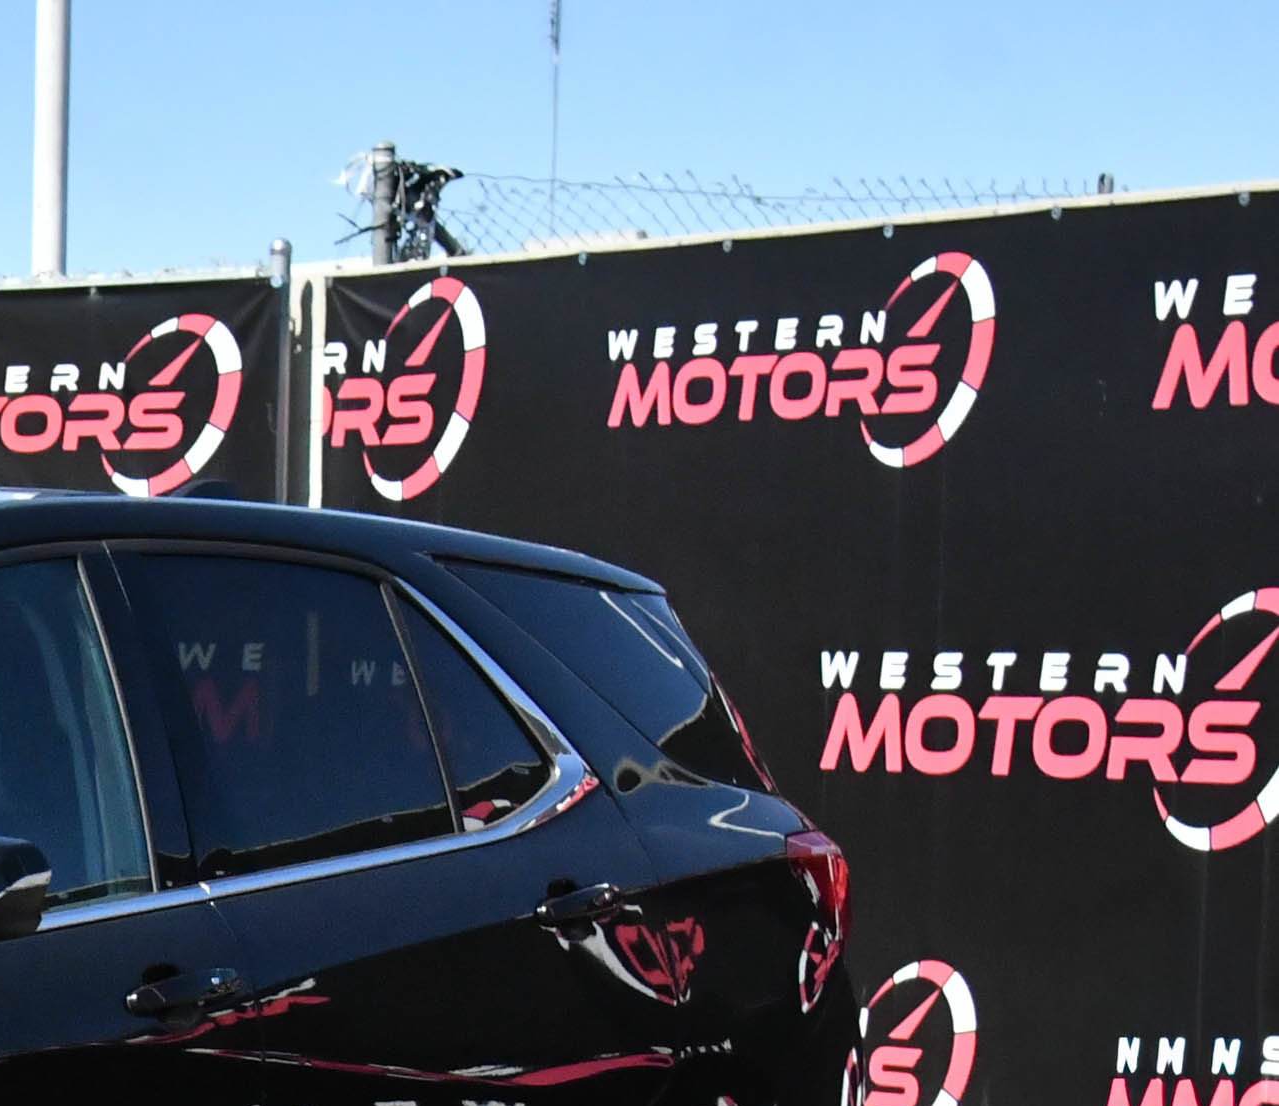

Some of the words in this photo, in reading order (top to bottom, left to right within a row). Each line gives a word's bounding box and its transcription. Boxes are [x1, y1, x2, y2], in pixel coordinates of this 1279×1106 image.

[607, 309, 887, 362] WESTERN
[323, 372, 438, 449] RS
[607, 343, 942, 429] MOTORS
[820, 650, 1188, 695] WESTERN
[819, 691, 1262, 785] MOTORS
